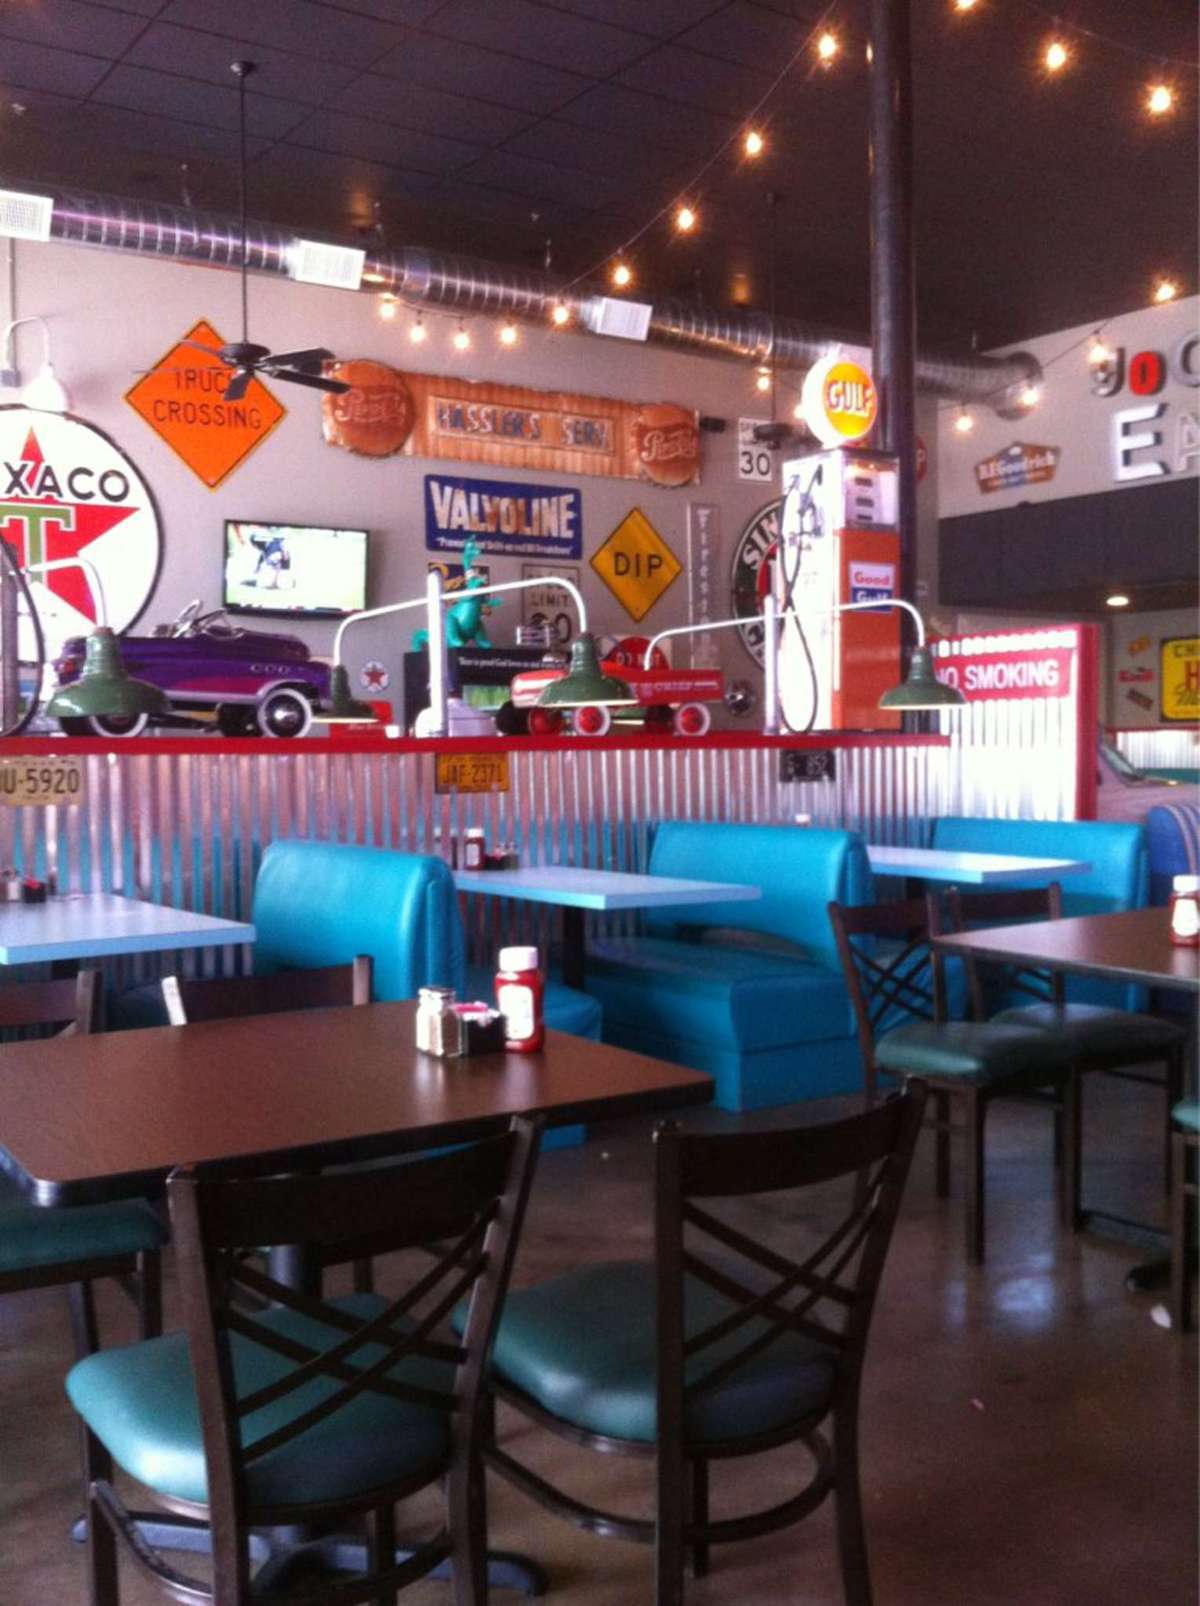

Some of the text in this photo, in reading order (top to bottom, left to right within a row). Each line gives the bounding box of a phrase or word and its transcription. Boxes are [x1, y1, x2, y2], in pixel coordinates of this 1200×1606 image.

[174, 367, 232, 394] TRUC
[829, 379, 873, 416] GULF
[153, 399, 262, 430] CROSSING
[740, 450, 771, 477] 30
[4, 461, 130, 502] XACO
[430, 480, 576, 539] VALVOLINE
[614, 551, 663, 578] DIP
[854, 571, 891, 587] Good
[936, 659, 1059, 690] NO SMOKING
